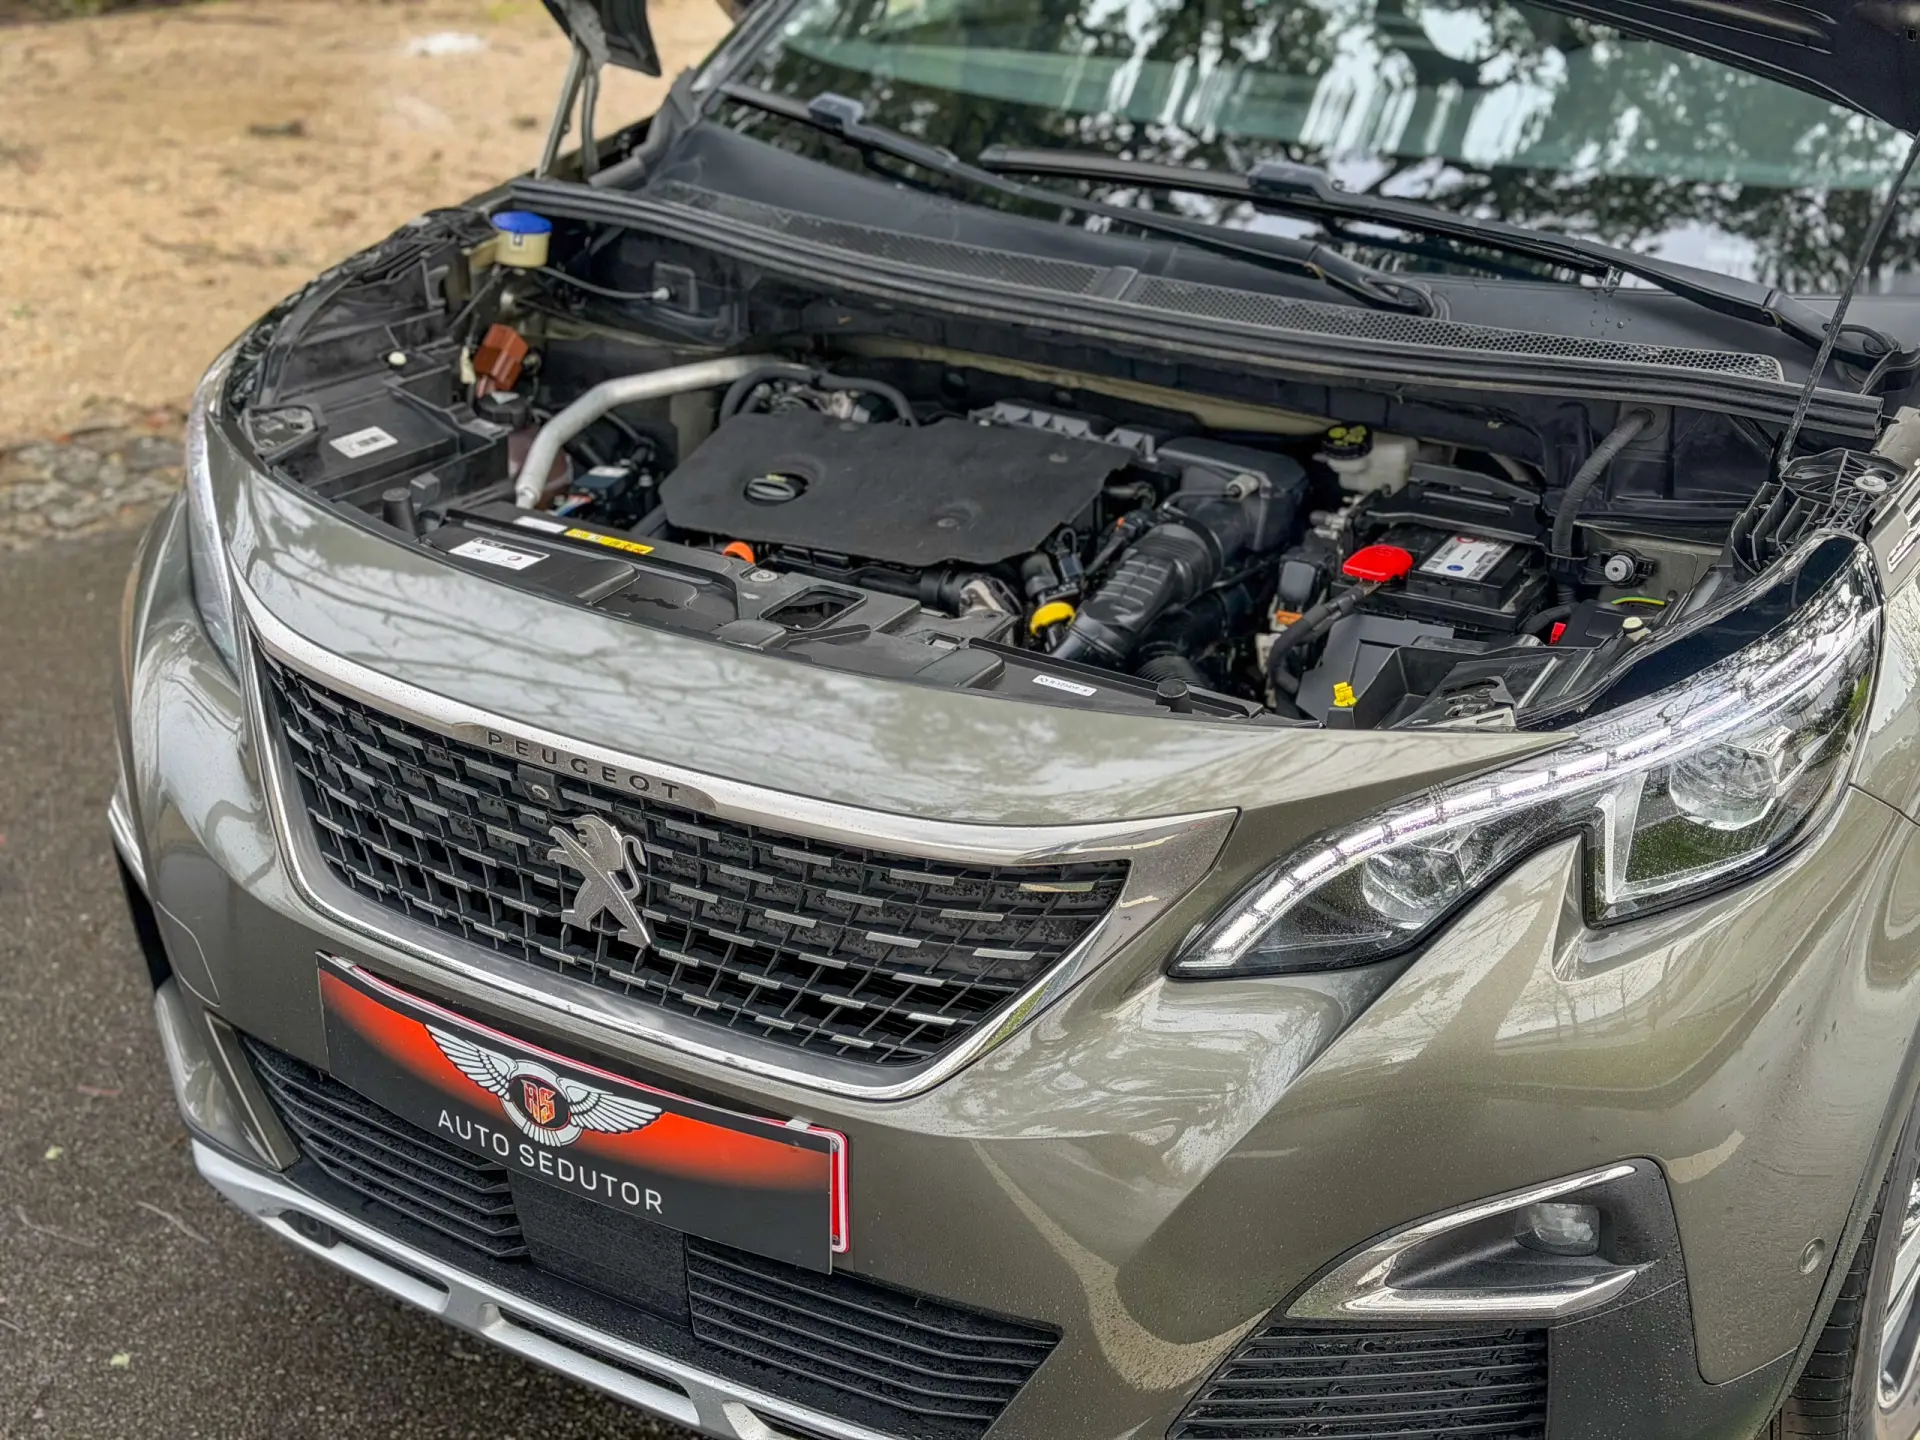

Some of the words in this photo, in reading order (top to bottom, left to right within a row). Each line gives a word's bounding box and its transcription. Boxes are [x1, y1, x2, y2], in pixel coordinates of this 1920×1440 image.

[488, 731, 679, 799] PEUGEOT
[438, 1109, 509, 1157] AUTO
[519, 1143, 663, 1214] SEDUTOR
